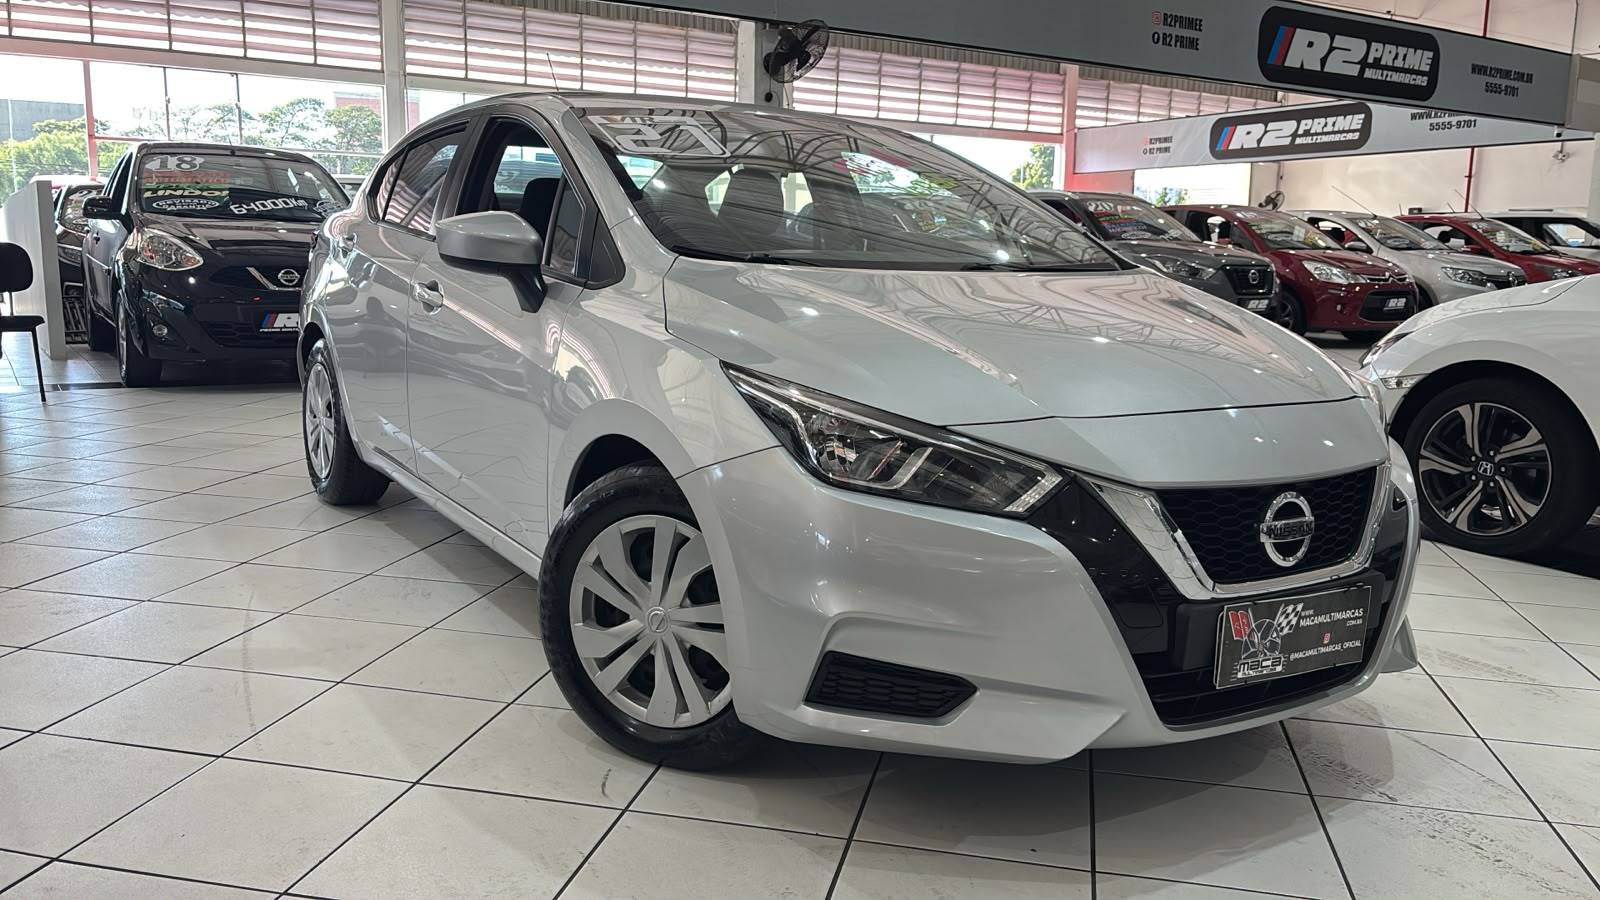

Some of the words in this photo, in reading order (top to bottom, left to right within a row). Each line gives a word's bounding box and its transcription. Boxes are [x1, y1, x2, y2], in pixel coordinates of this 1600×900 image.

[1162, 12, 1203, 32] R2PRIMEE
[1161, 32, 1173, 48] R2
[1174, 34, 1200, 51] PRIME
[1283, 28, 1368, 77] R2
[1366, 42, 1434, 72] PRIME
[1363, 67, 1429, 87] MULTIMARCAS
[1484, 81, 1519, 97] 5555-9701
[1228, 120, 1298, 150] R2
[1297, 113, 1365, 135] PRIME
[1428, 119, 1477, 131] 5555-9701
[1294, 132, 1360, 145] MULTIMARCAS
[153, 155, 200, 171] 18
[1267, 520, 1313, 540] NISSAN
[1299, 608, 1364, 628] MACAMULTIMARCAS
[1289, 639, 1362, 661] @MACAMULTIMARCAS_OFICIAL
